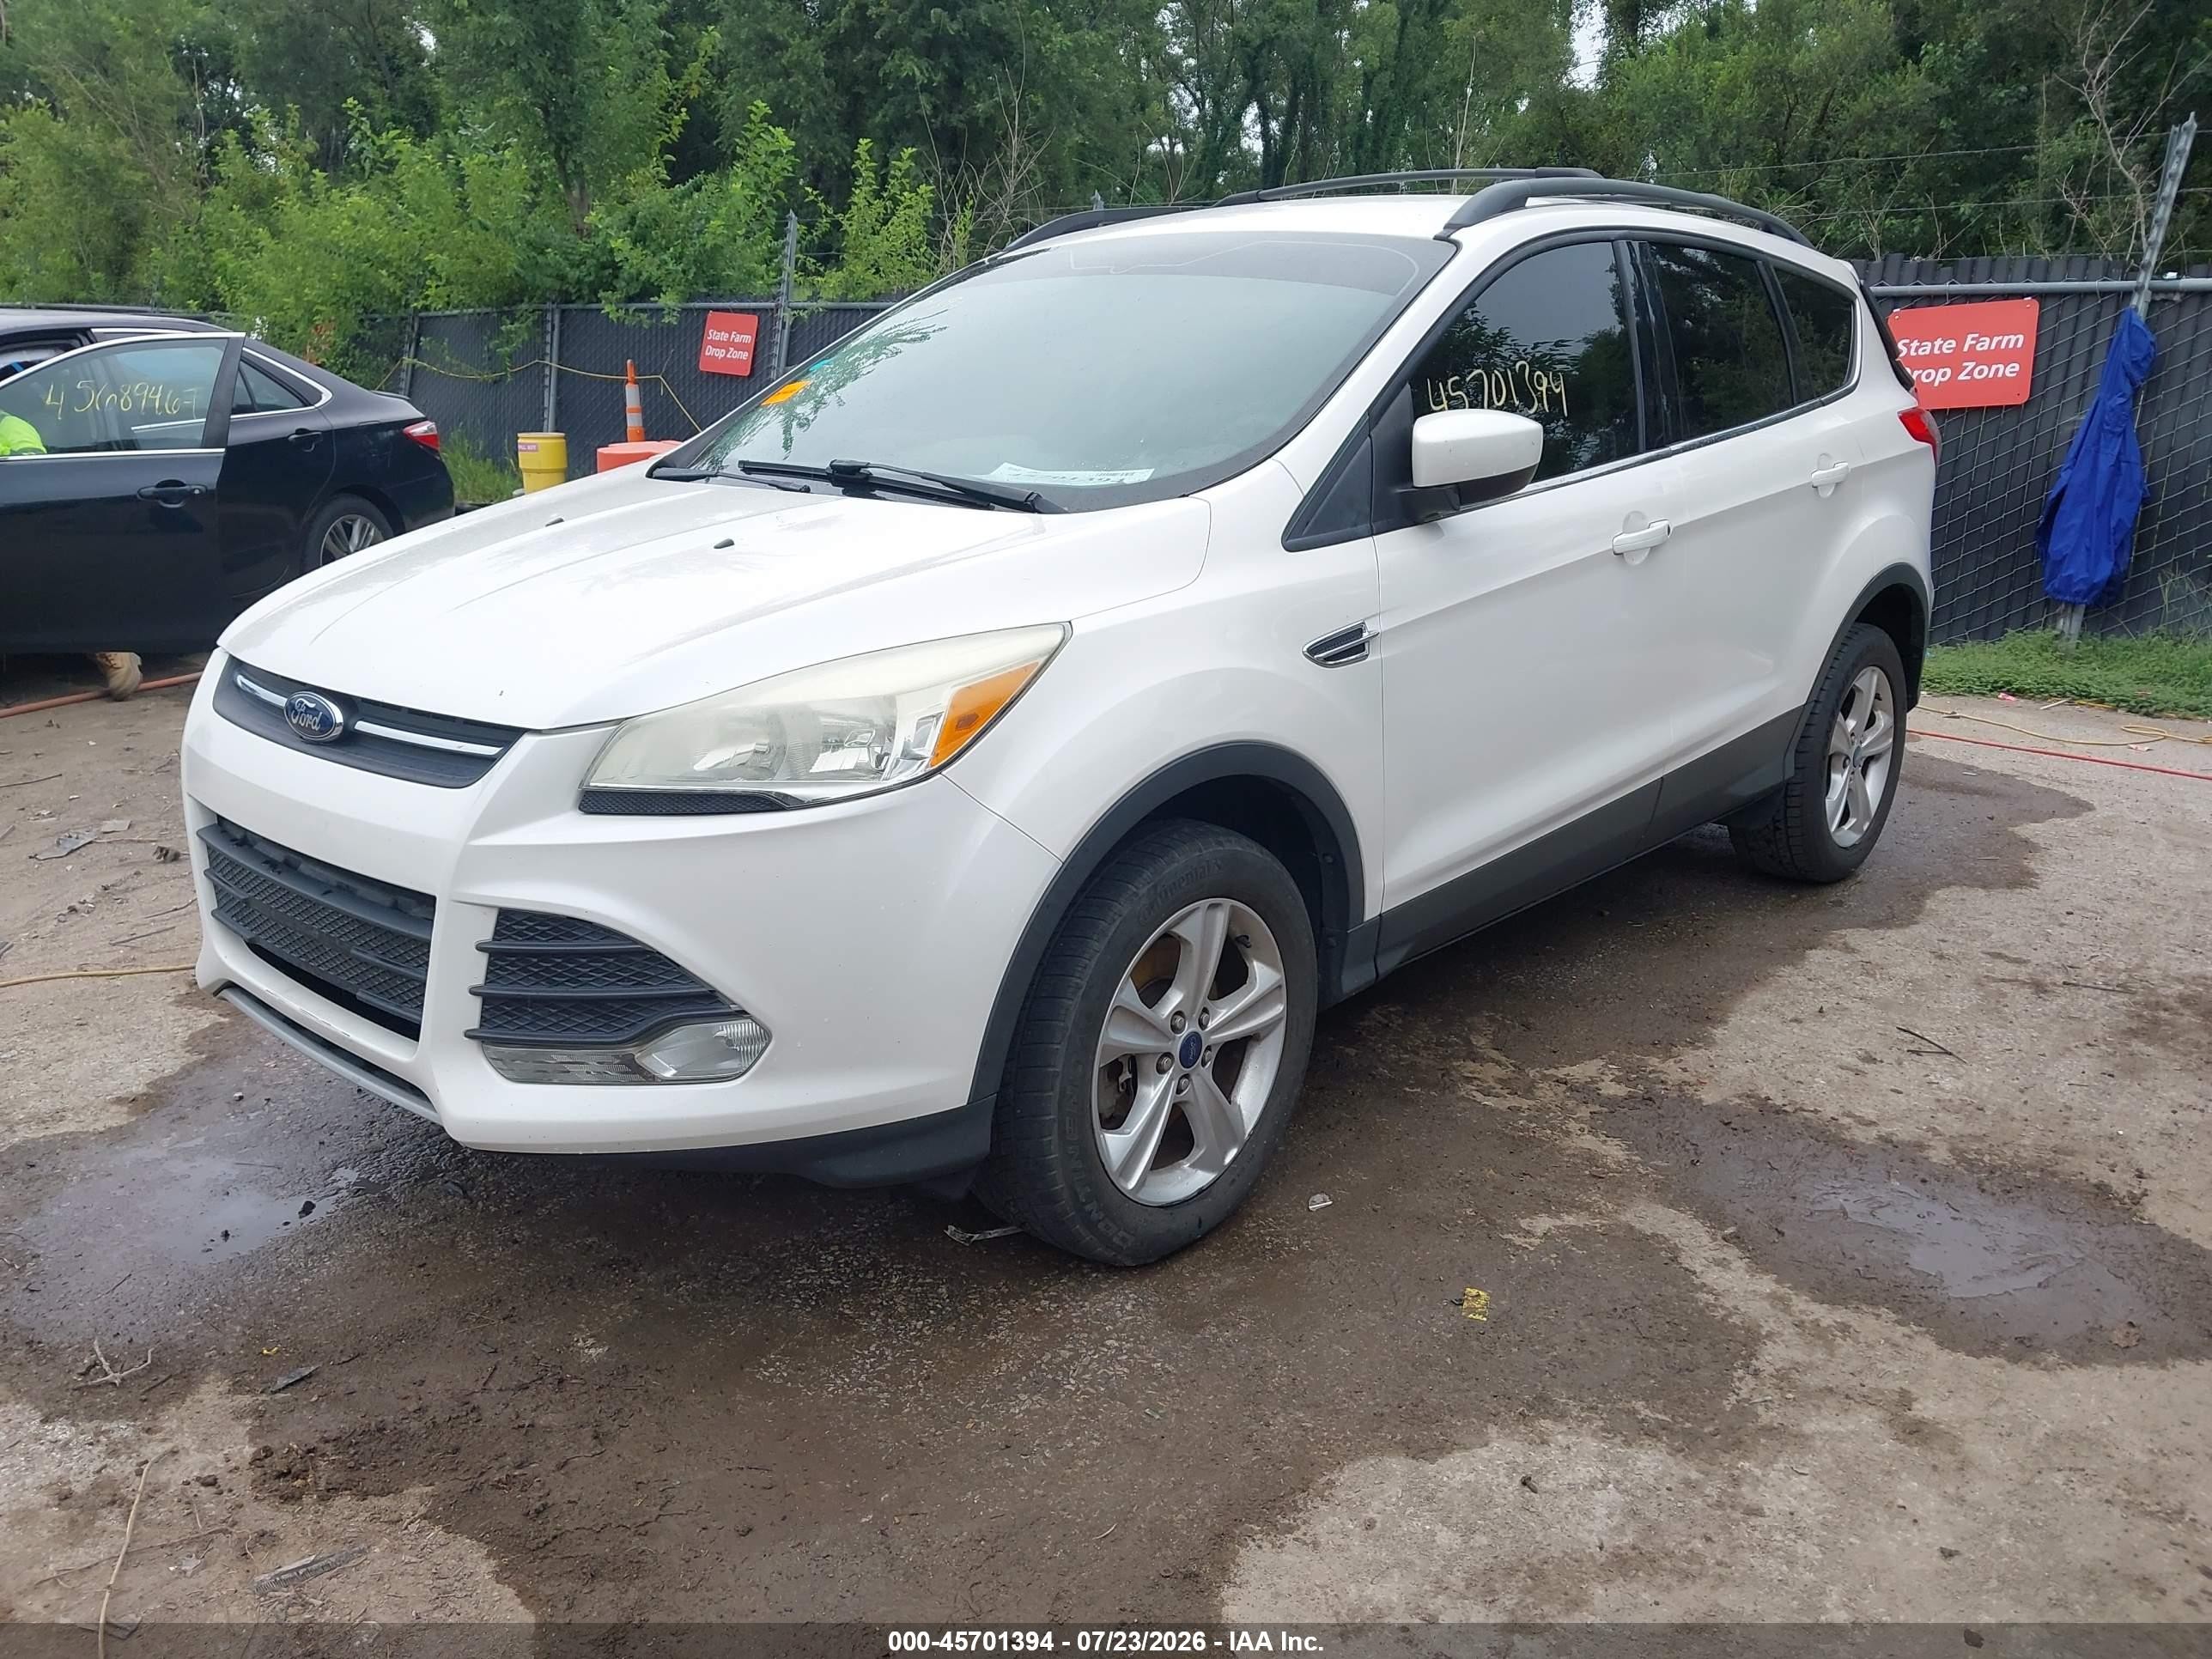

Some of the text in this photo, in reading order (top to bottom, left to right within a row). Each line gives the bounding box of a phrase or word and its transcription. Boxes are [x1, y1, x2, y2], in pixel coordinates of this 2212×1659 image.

[707, 329, 751, 344] State Farm
[1896, 332, 2025, 357] State Farm
[705, 345, 749, 361] Drop Zone
[1958, 361, 2021, 380] Zone
[290, 697, 323, 732] Ford
